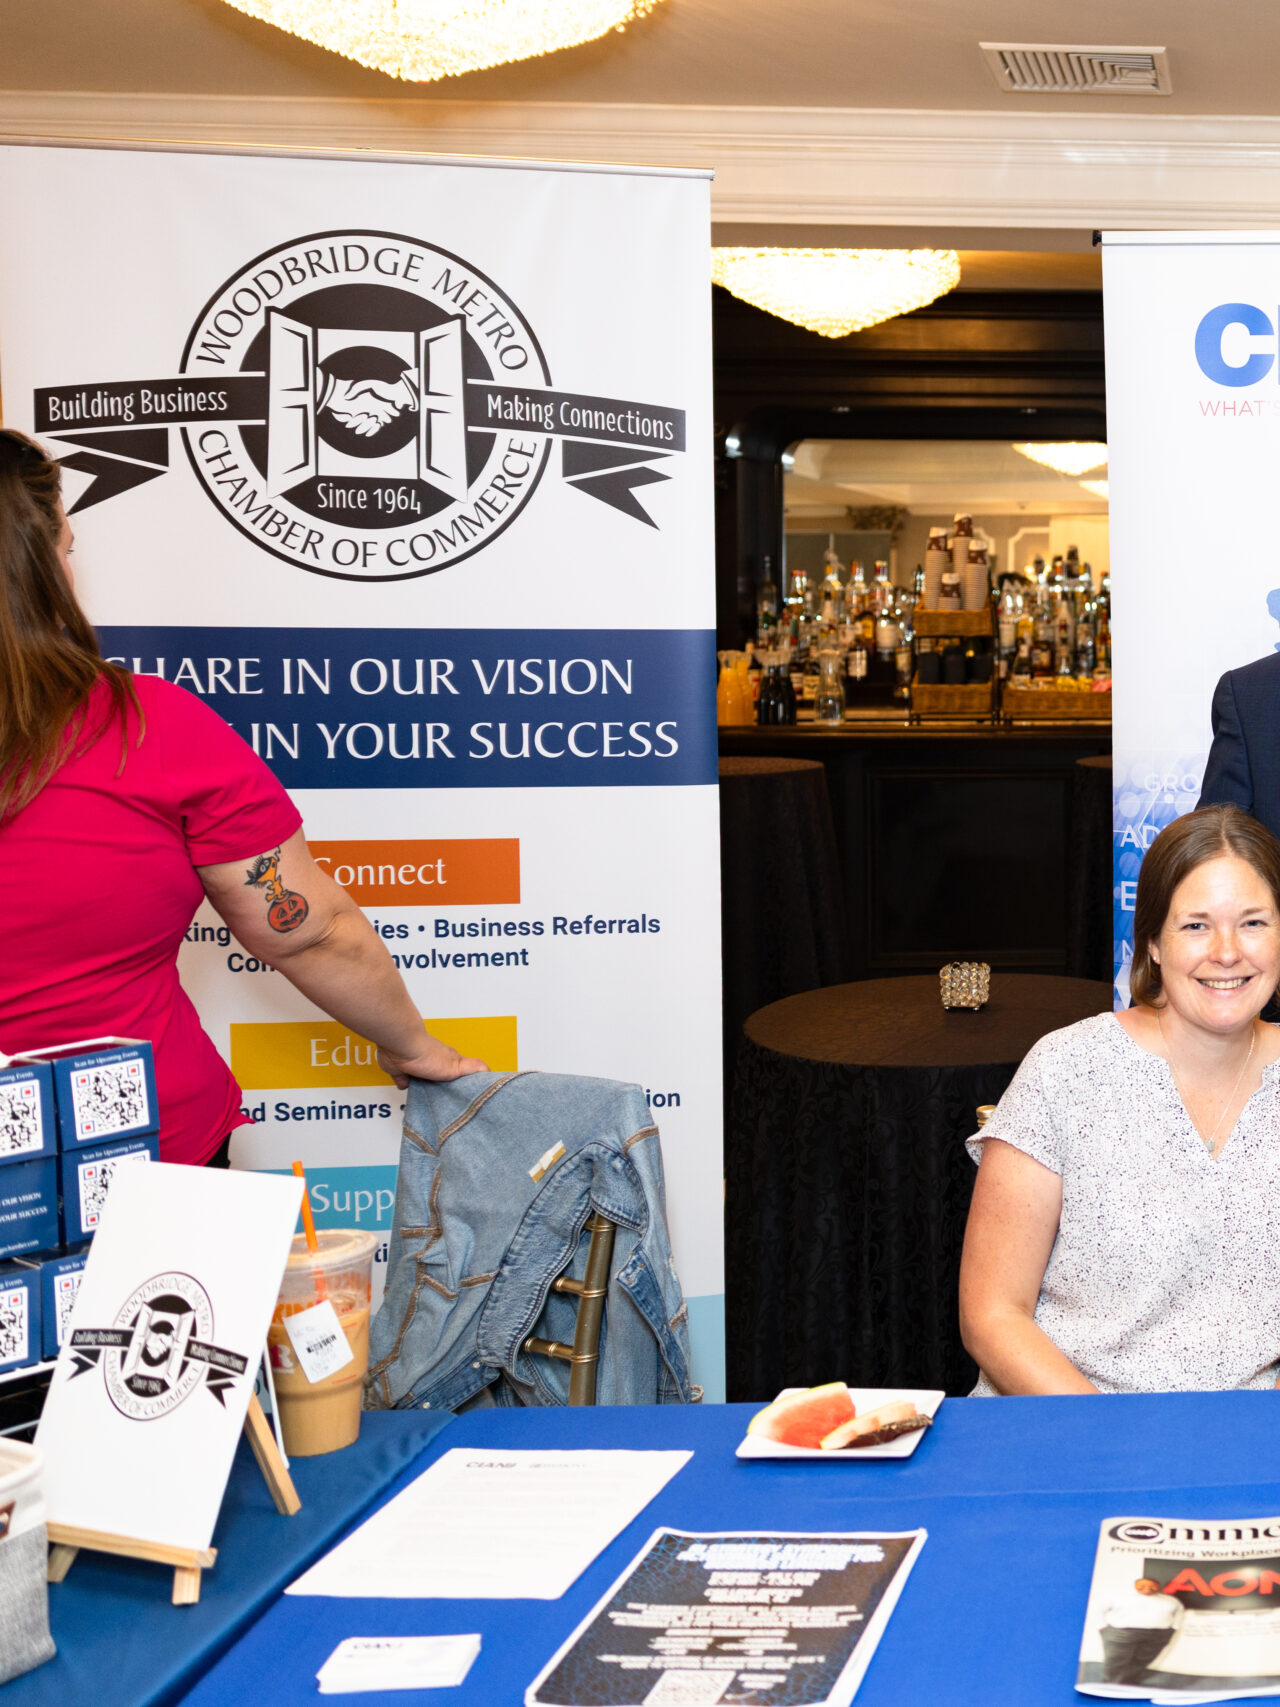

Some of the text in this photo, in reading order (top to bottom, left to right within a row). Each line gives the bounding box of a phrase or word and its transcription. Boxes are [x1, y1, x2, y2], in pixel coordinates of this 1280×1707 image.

[194, 243, 530, 373] WOODBRIDGE METRO
[48, 387, 229, 423] Building Business
[486, 393, 675, 443] Making Connections
[198, 428, 538, 569] CHAMBER OF COMMERCE
[316, 482, 423, 515] Since 1964
[104, 656, 634, 697] HARE IN OUR VISION
[251, 720, 680, 760] IN YOUR SUCCESS
[434, 917, 546, 939] Business
[551, 913, 661, 936] Referrals
[274, 1100, 392, 1122] Seminars
[1110, 1545, 1196, 1558] Prioritizing
